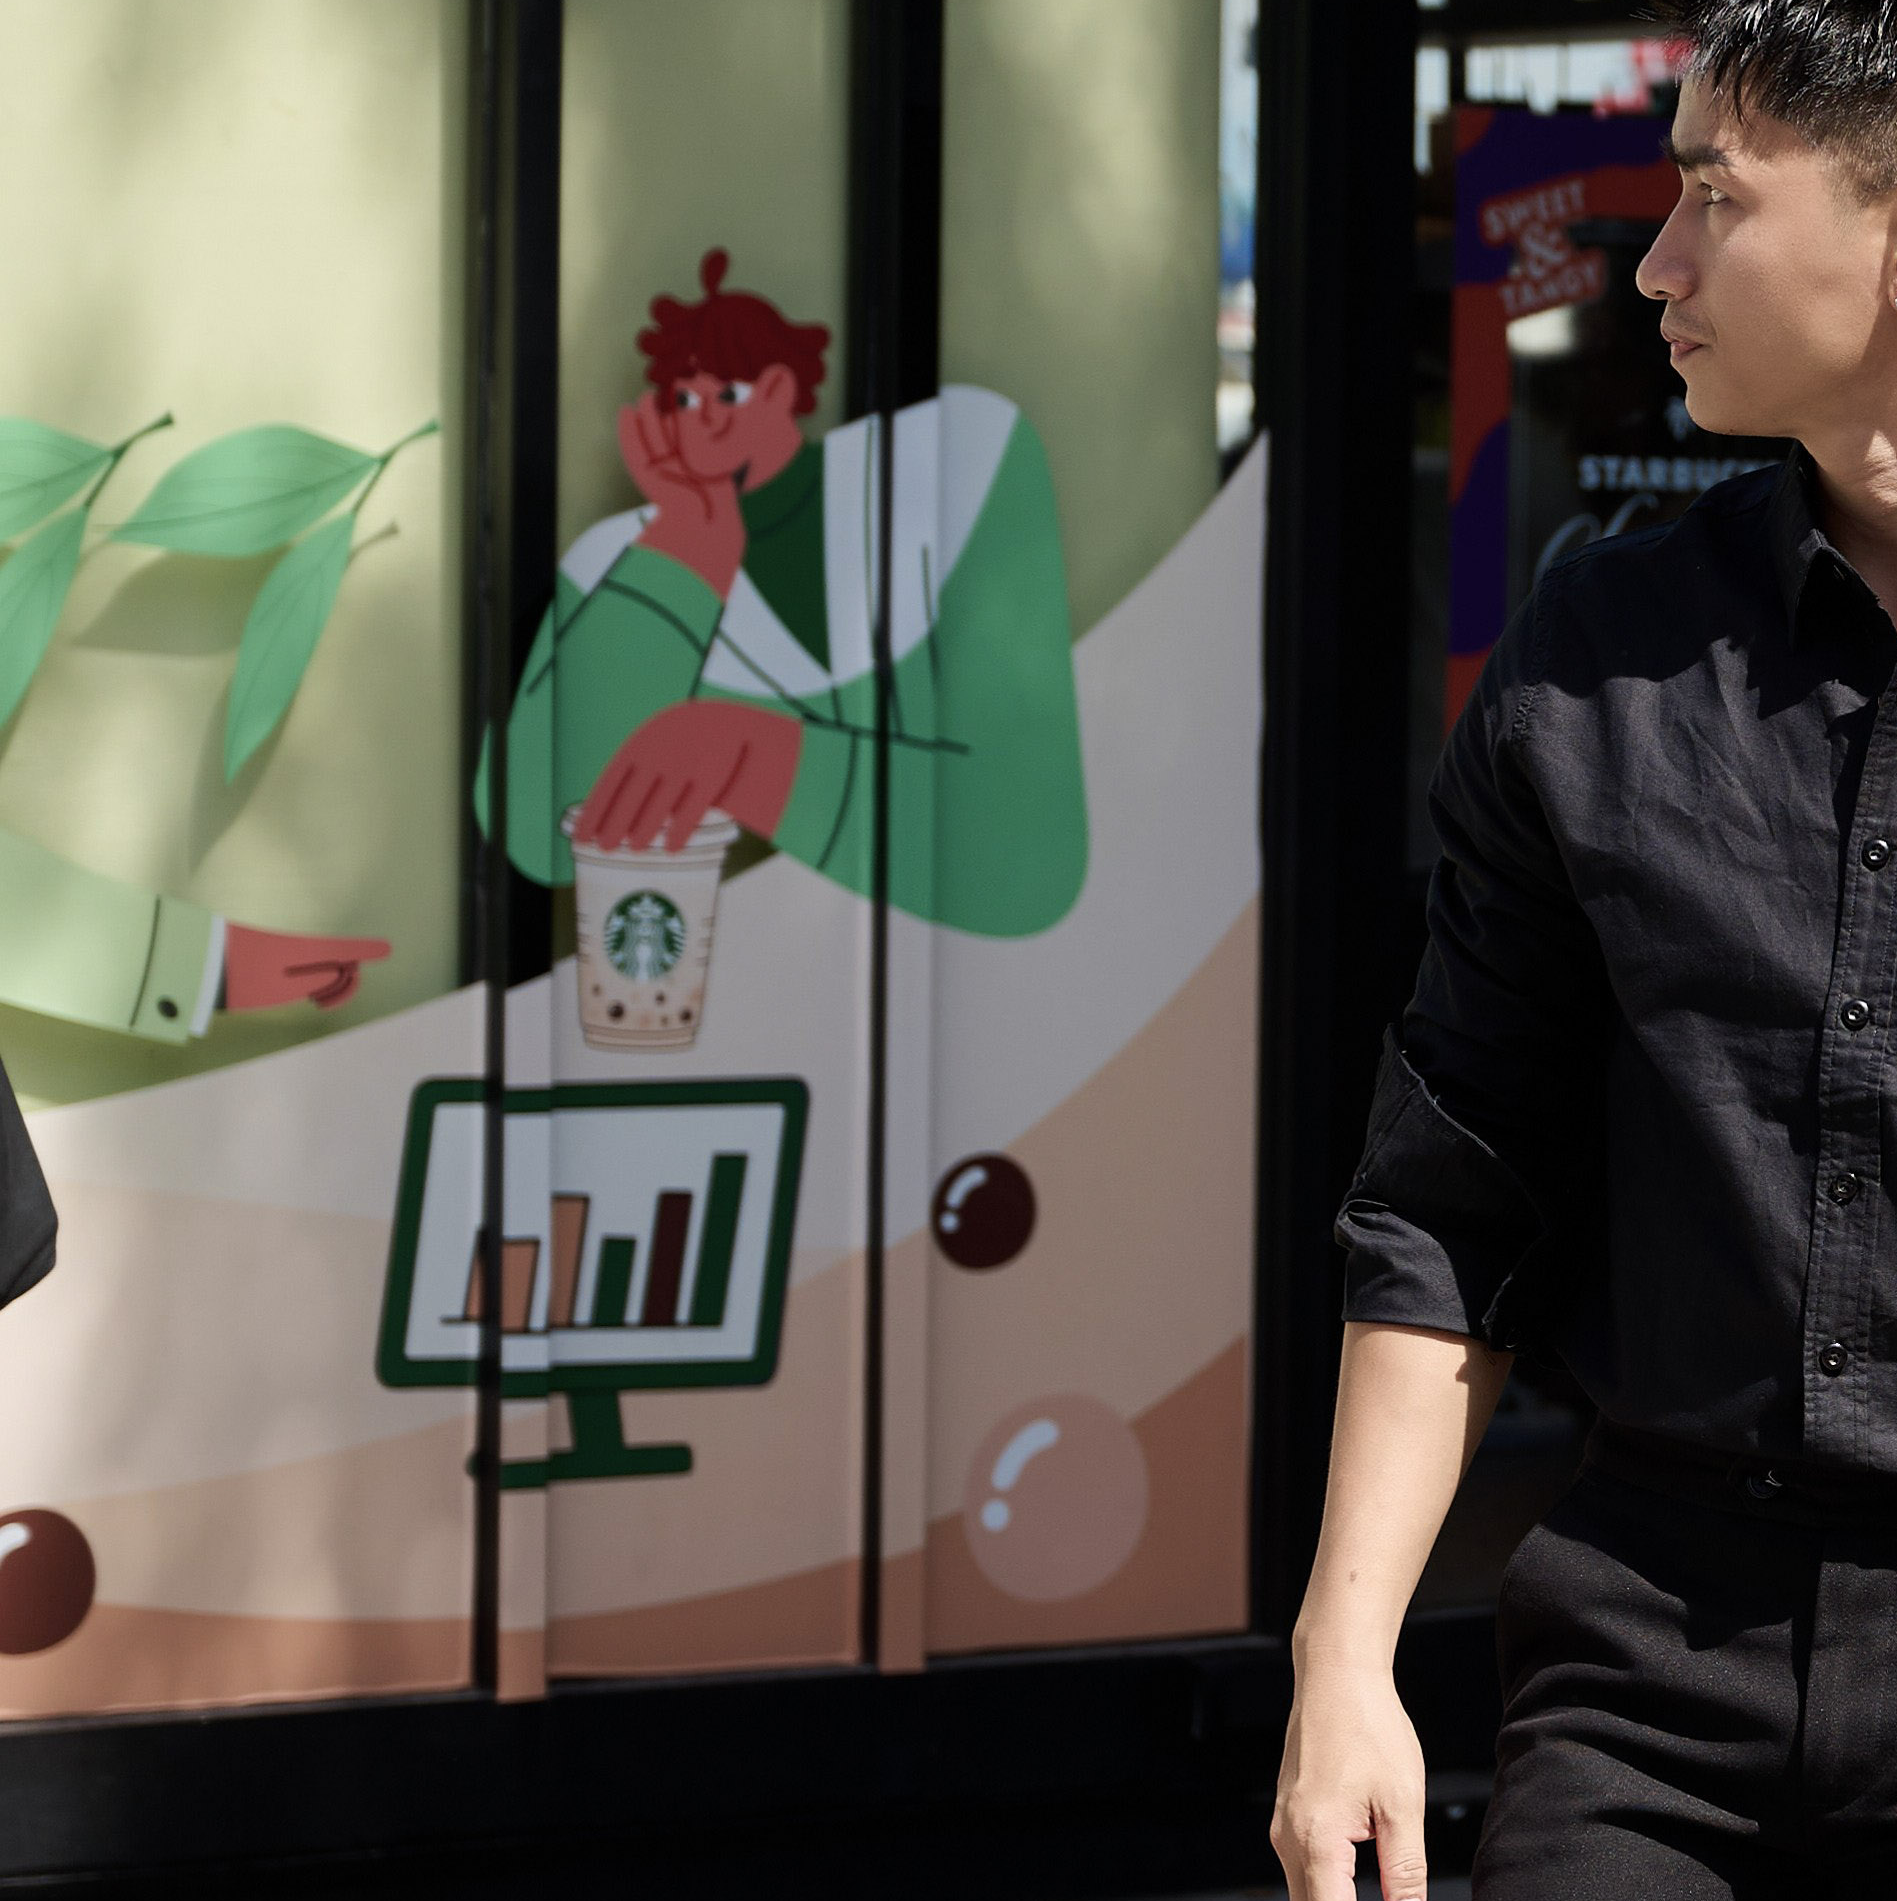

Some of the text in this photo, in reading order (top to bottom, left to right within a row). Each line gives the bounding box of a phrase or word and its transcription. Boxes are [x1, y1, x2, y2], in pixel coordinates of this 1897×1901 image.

[1482, 176, 1587, 242] SWEET
[1519, 221, 1570, 281] &
[1499, 259, 1604, 316] TANGY
